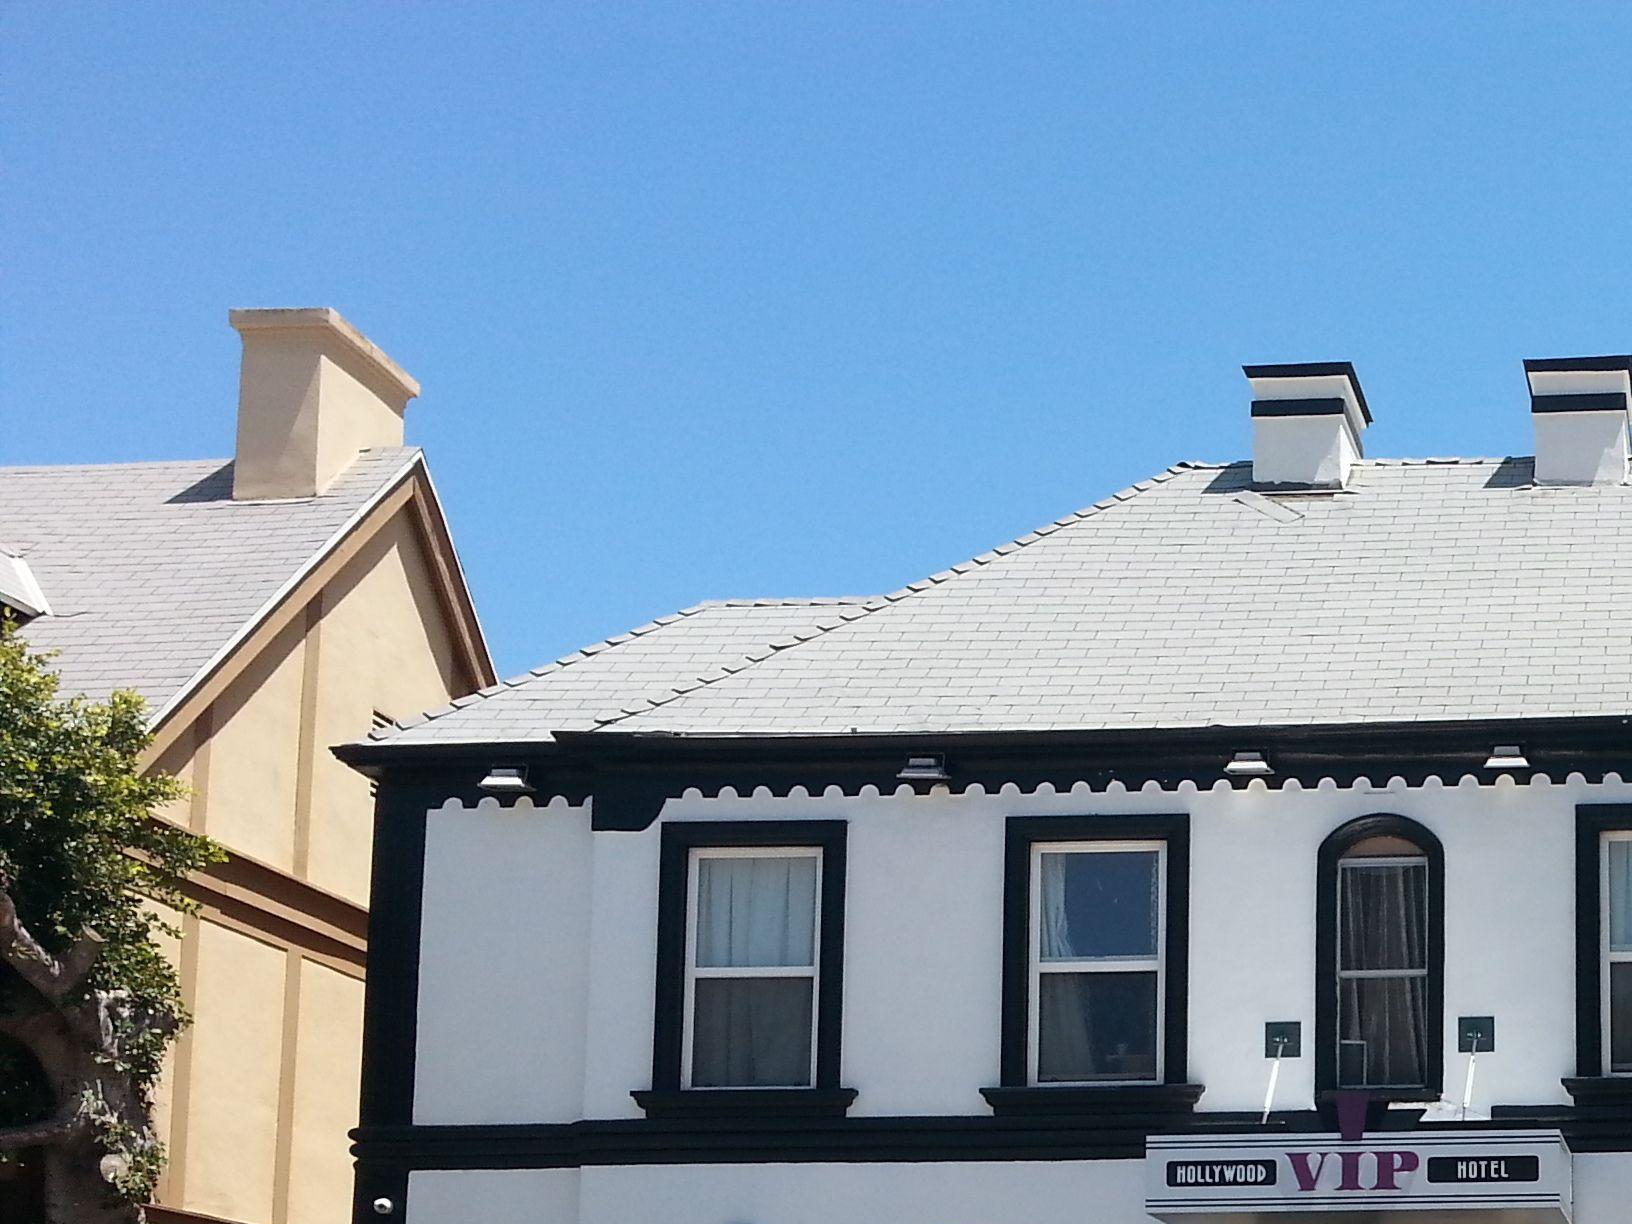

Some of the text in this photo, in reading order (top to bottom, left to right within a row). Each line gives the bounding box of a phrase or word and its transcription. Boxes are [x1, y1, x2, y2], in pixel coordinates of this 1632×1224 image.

[1176, 1151, 1509, 1191] HOLLYWOOD VIP HOTEL
